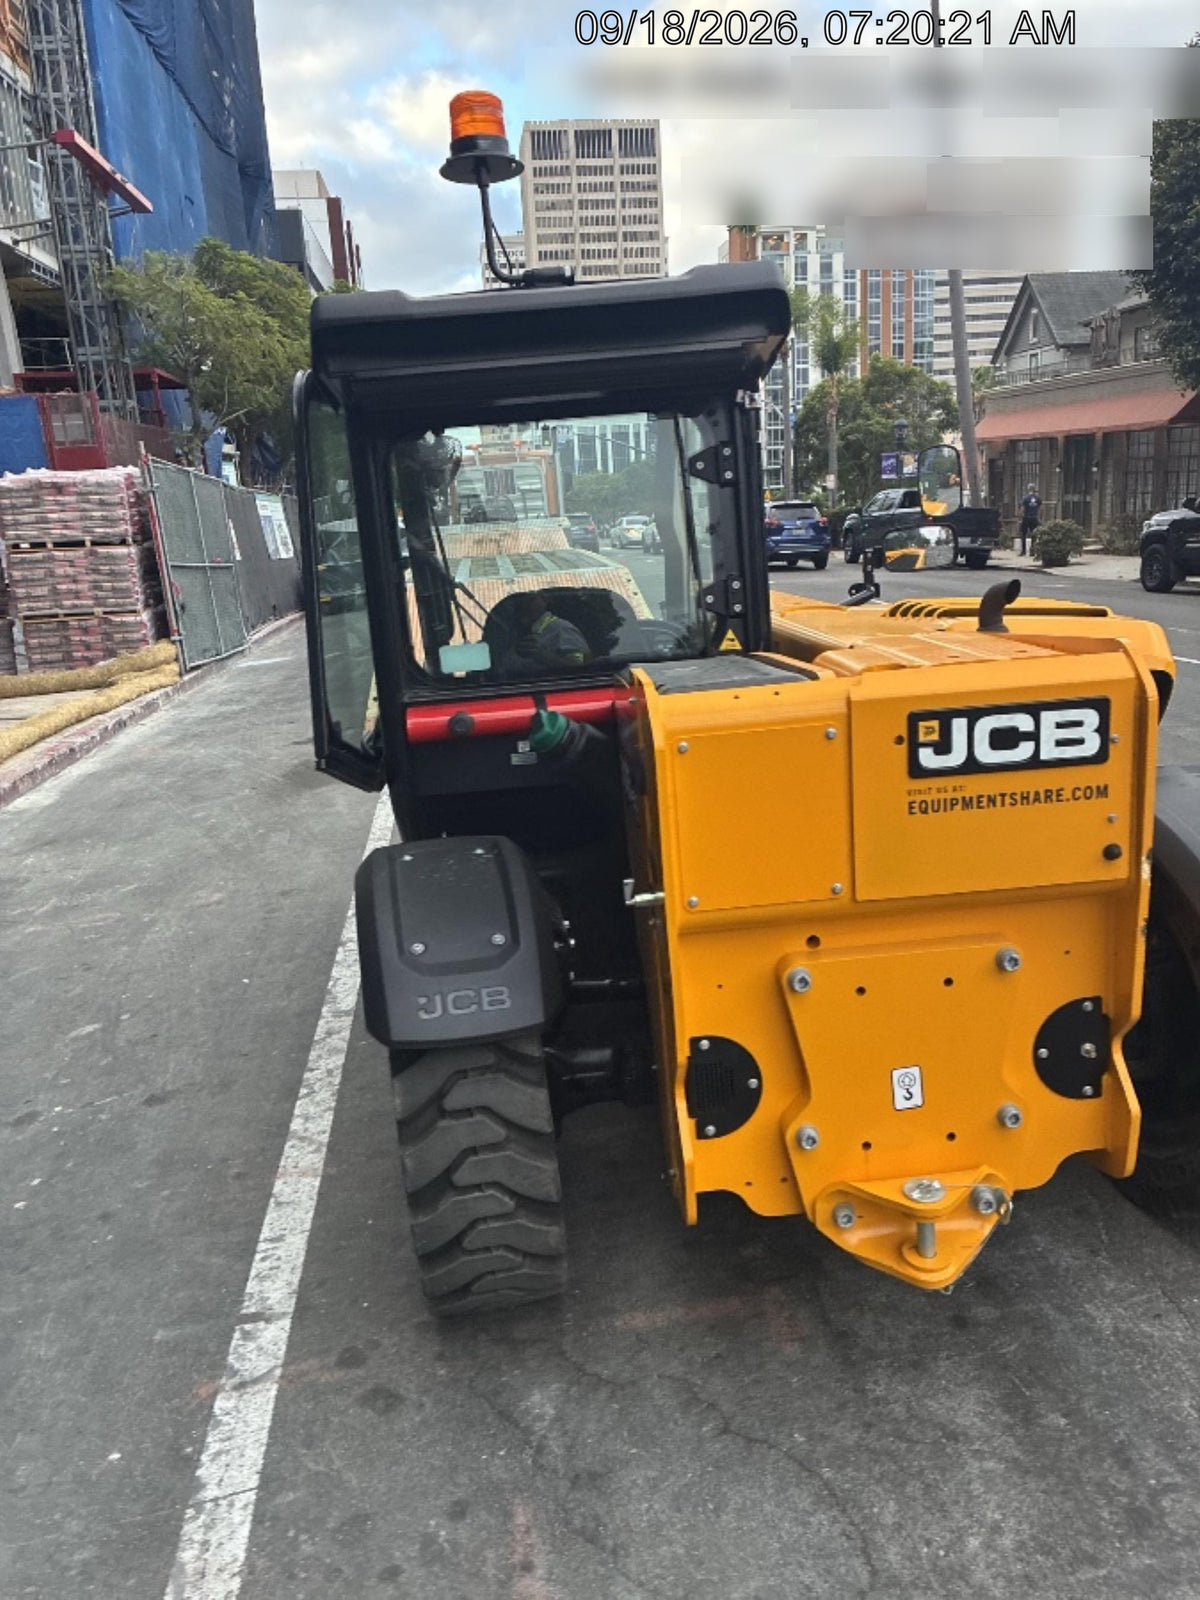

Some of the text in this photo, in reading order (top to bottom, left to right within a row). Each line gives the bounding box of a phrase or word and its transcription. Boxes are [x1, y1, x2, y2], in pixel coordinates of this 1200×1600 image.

[918, 708, 1101, 769] JCB
[908, 784, 1109, 815] EQUIPMENTSHARE.COM
[417, 986, 511, 1019] JCB
